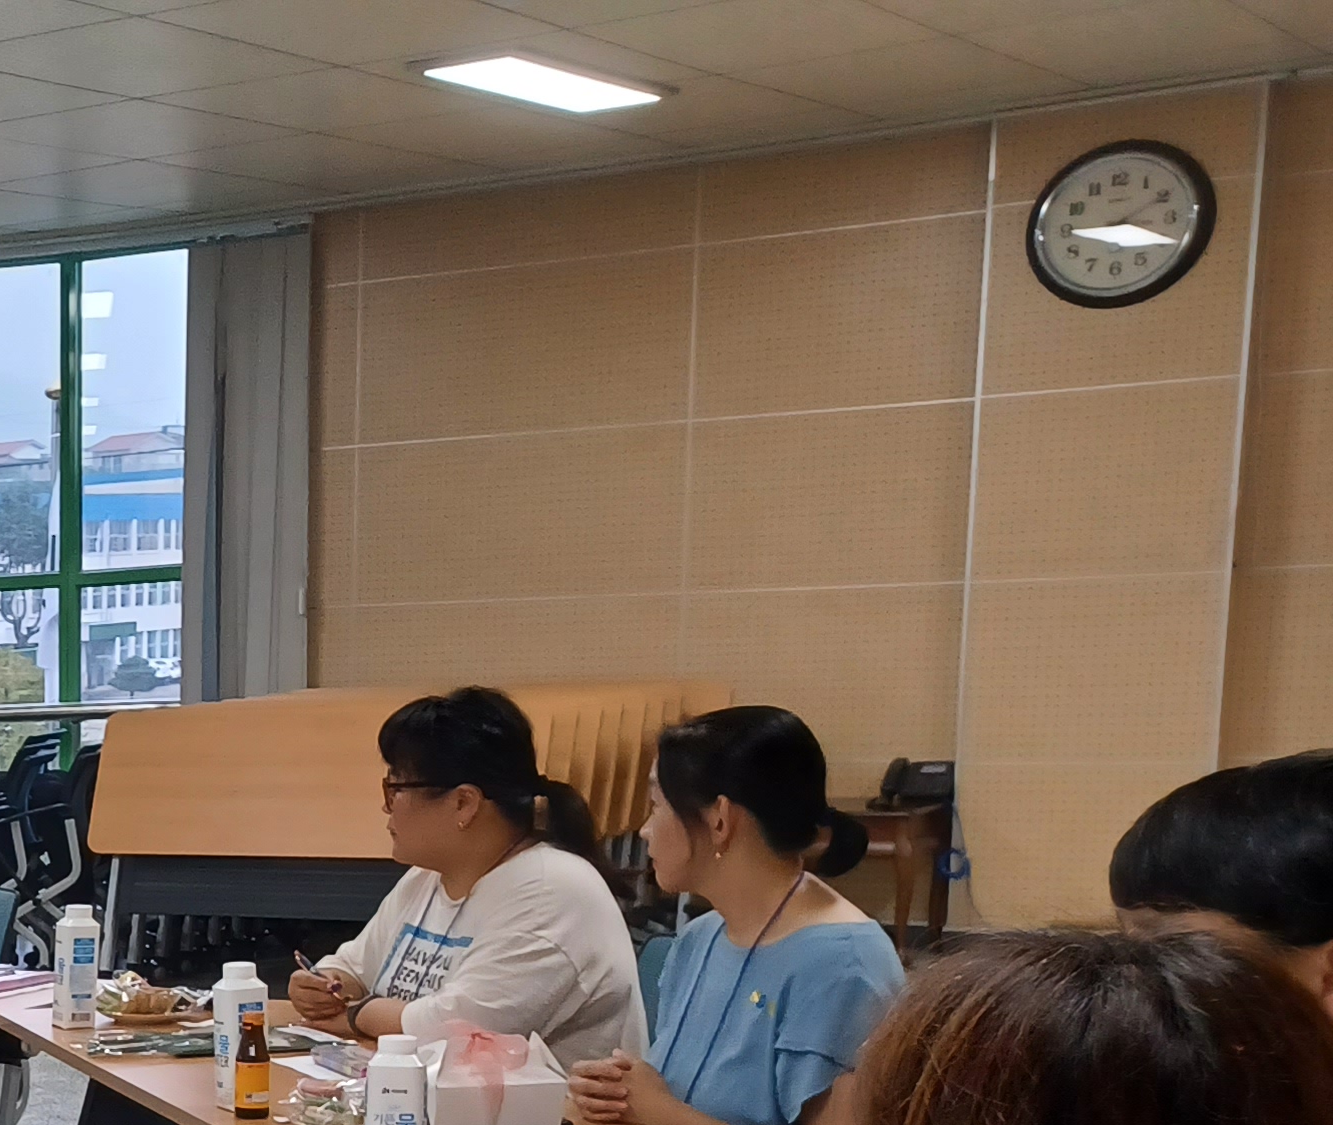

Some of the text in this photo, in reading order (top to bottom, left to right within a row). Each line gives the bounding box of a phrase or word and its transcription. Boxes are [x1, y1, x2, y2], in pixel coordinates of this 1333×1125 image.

[1112, 171, 1130, 187] 12
[1088, 182, 1102, 197] 11
[1069, 201, 1085, 216] 10
[1085, 257, 1097, 272] 7
[1134, 252, 1147, 266] 5
[1109, 261, 1123, 276] 6
